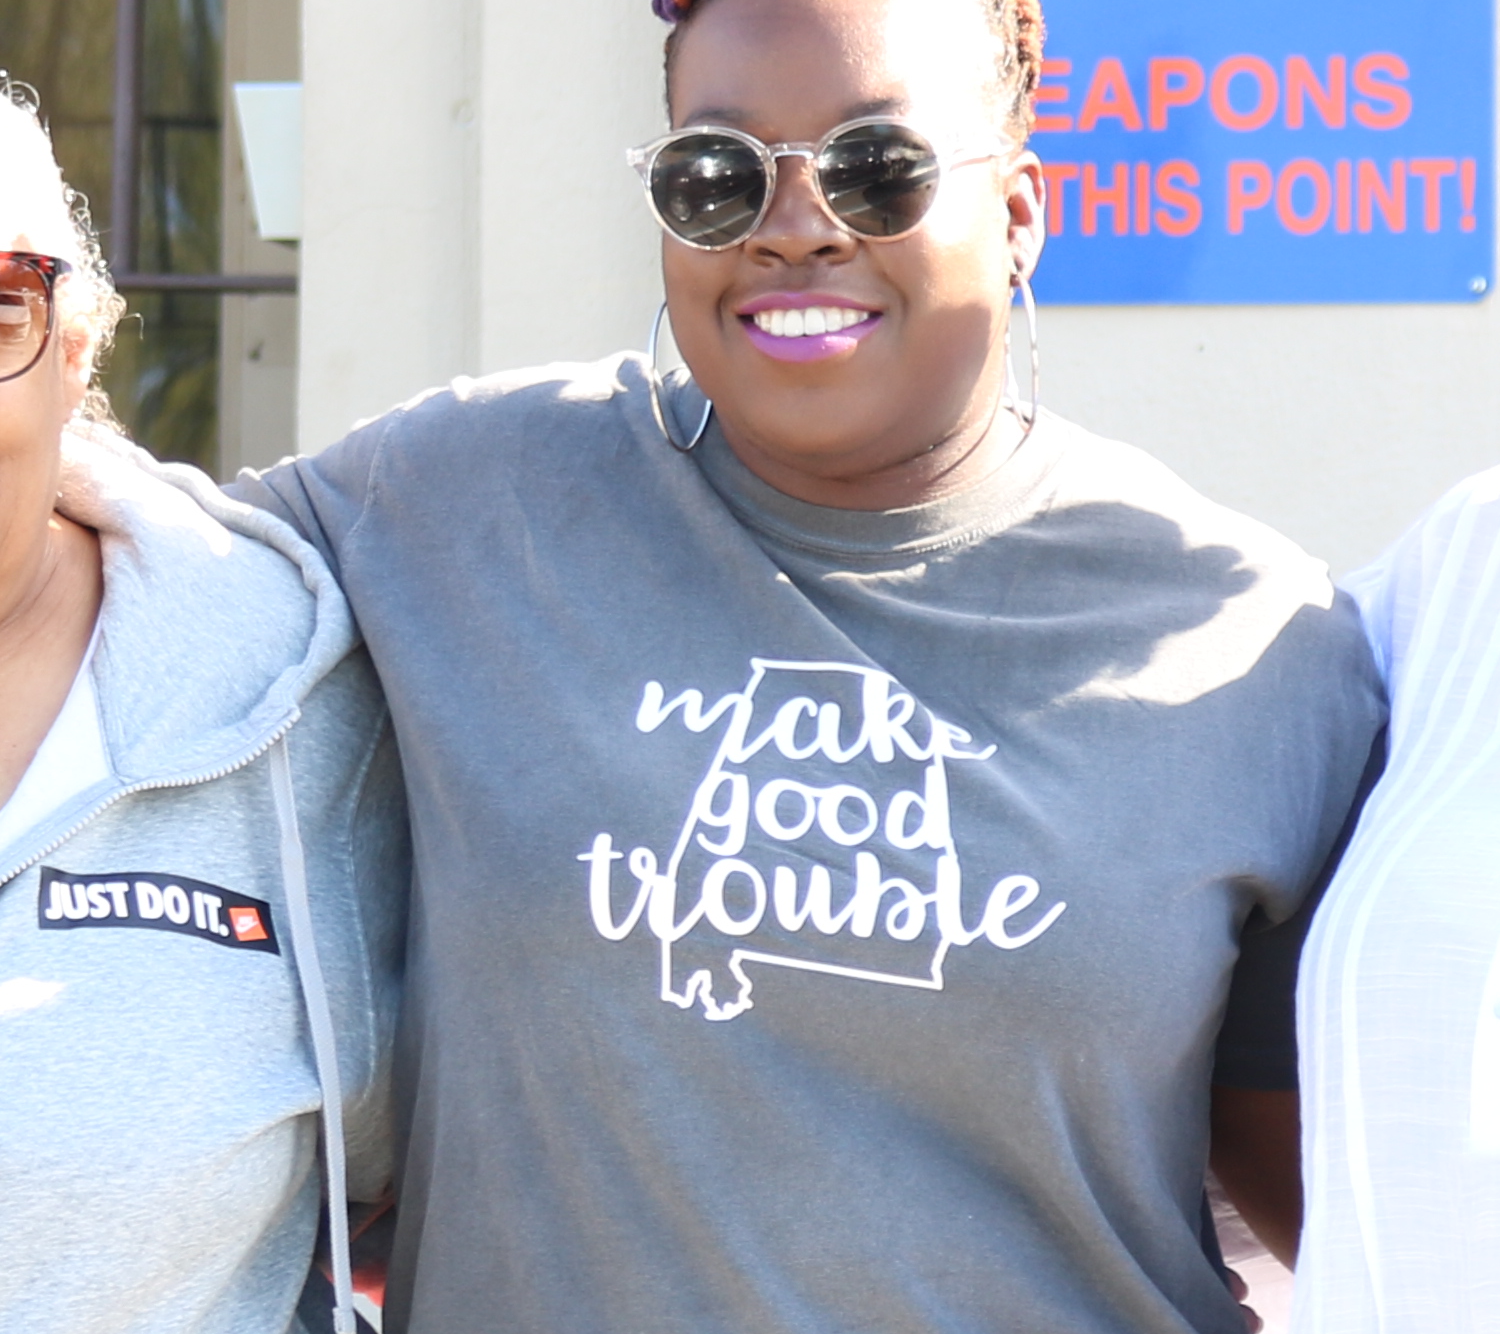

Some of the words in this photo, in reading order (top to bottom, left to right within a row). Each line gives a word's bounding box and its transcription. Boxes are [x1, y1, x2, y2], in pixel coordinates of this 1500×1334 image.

[1033, 52, 1413, 133] EAPONS
[1044, 160, 1202, 237] THIS
[1226, 157, 1477, 235] POINT!
[636, 673, 997, 764] make
[697, 765, 953, 855] good
[45, 881, 130, 920] JUST
[135, 881, 191, 924] DO
[193, 890, 230, 937] IT.
[576, 833, 1066, 949] trouble
